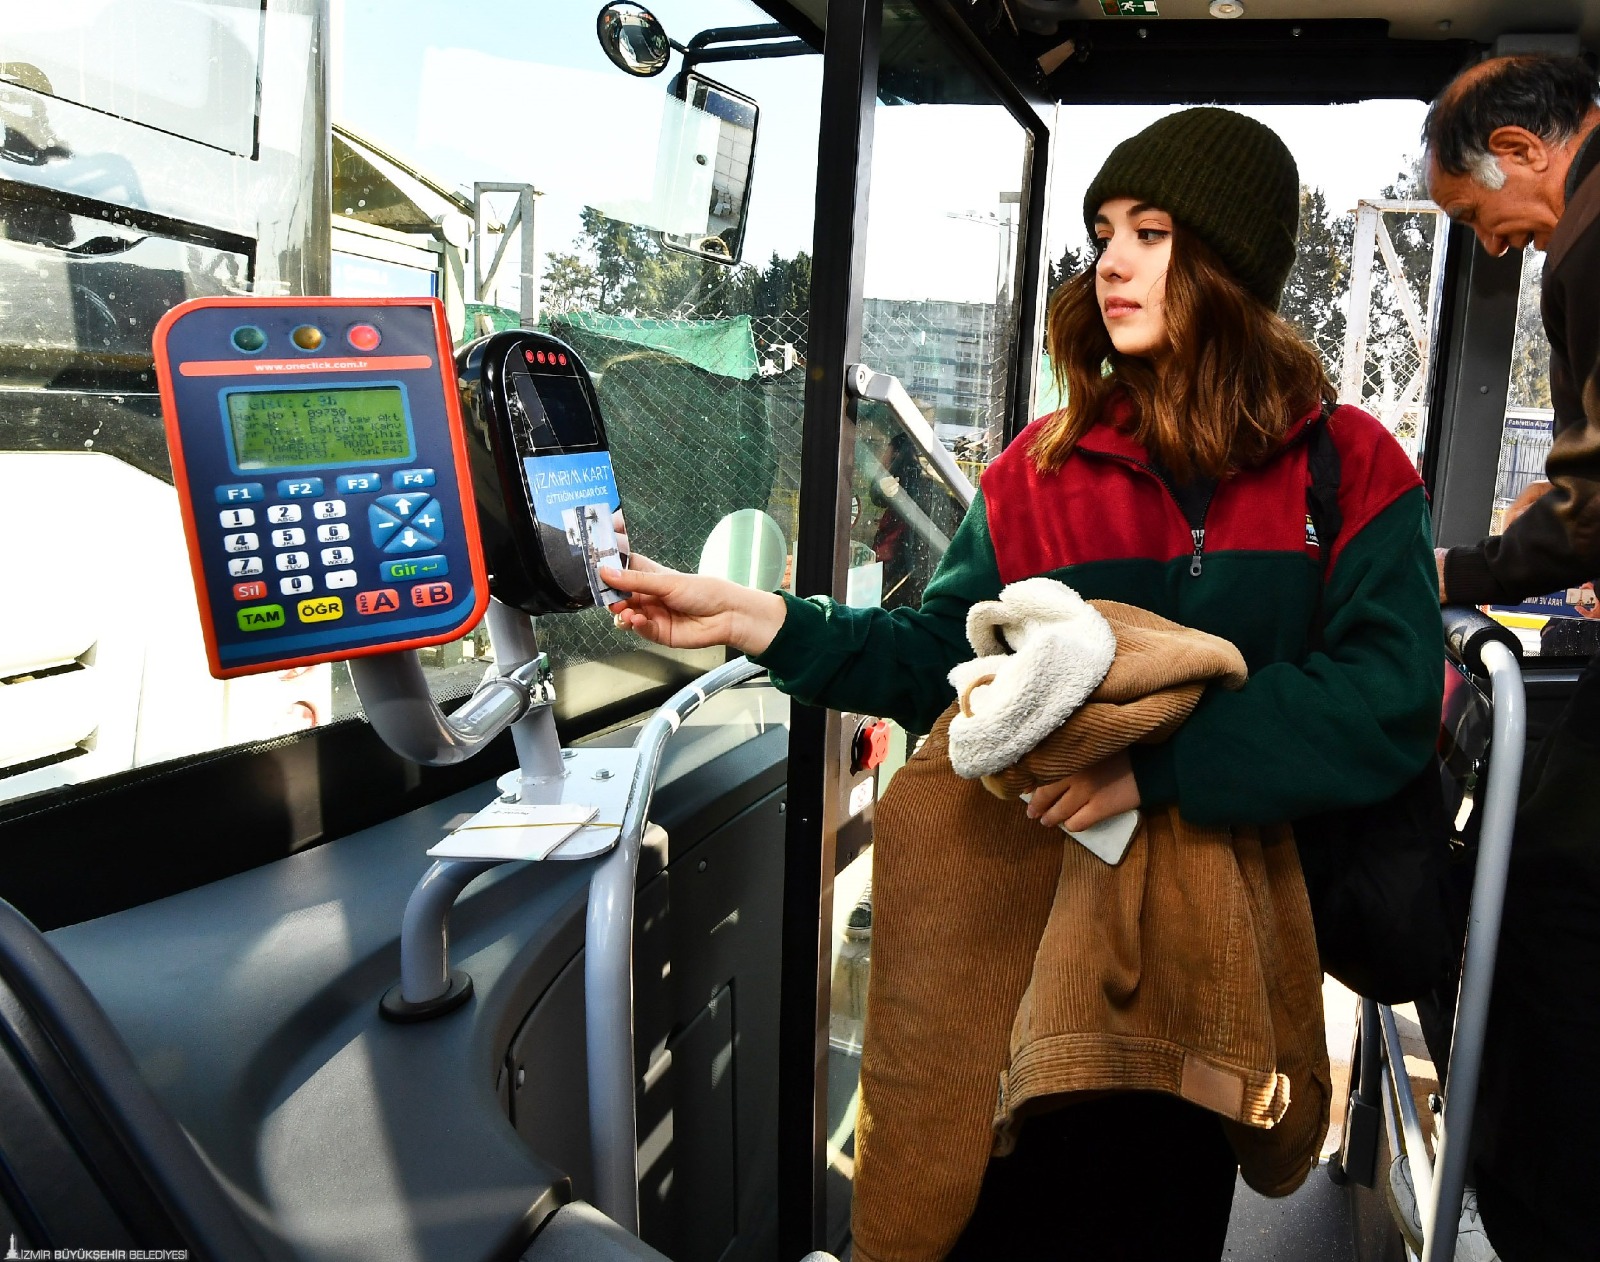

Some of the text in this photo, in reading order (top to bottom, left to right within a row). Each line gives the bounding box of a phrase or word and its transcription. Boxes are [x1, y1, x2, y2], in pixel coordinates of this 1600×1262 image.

[254, 361, 368, 371] www.oneclick.com.tr
[403, 474, 424, 485] F4
[582, 465, 609, 483] KART
[288, 483, 313, 495] F2
[347, 478, 369, 490] F3
[227, 488, 252, 500] F1
[574, 487, 595, 499] KADAR
[594, 485, 609, 497] ÖDE
[279, 506, 289, 518] 2
[325, 502, 335, 513] 3
[232, 510, 240, 523] 1
[282, 529, 293, 541] 5
[328, 525, 339, 537] 6
[236, 534, 248, 545] 4
[287, 553, 297, 565] 8
[331, 549, 342, 560] 9
[240, 558, 250, 570] 7
[390, 562, 417, 577] Gir
[291, 577, 302, 589] 0
[238, 584, 260, 598] Sil
[429, 584, 449, 604] B
[373, 591, 396, 611] A
[302, 602, 341, 617] ÖĞR
[242, 610, 280, 625] TAM
